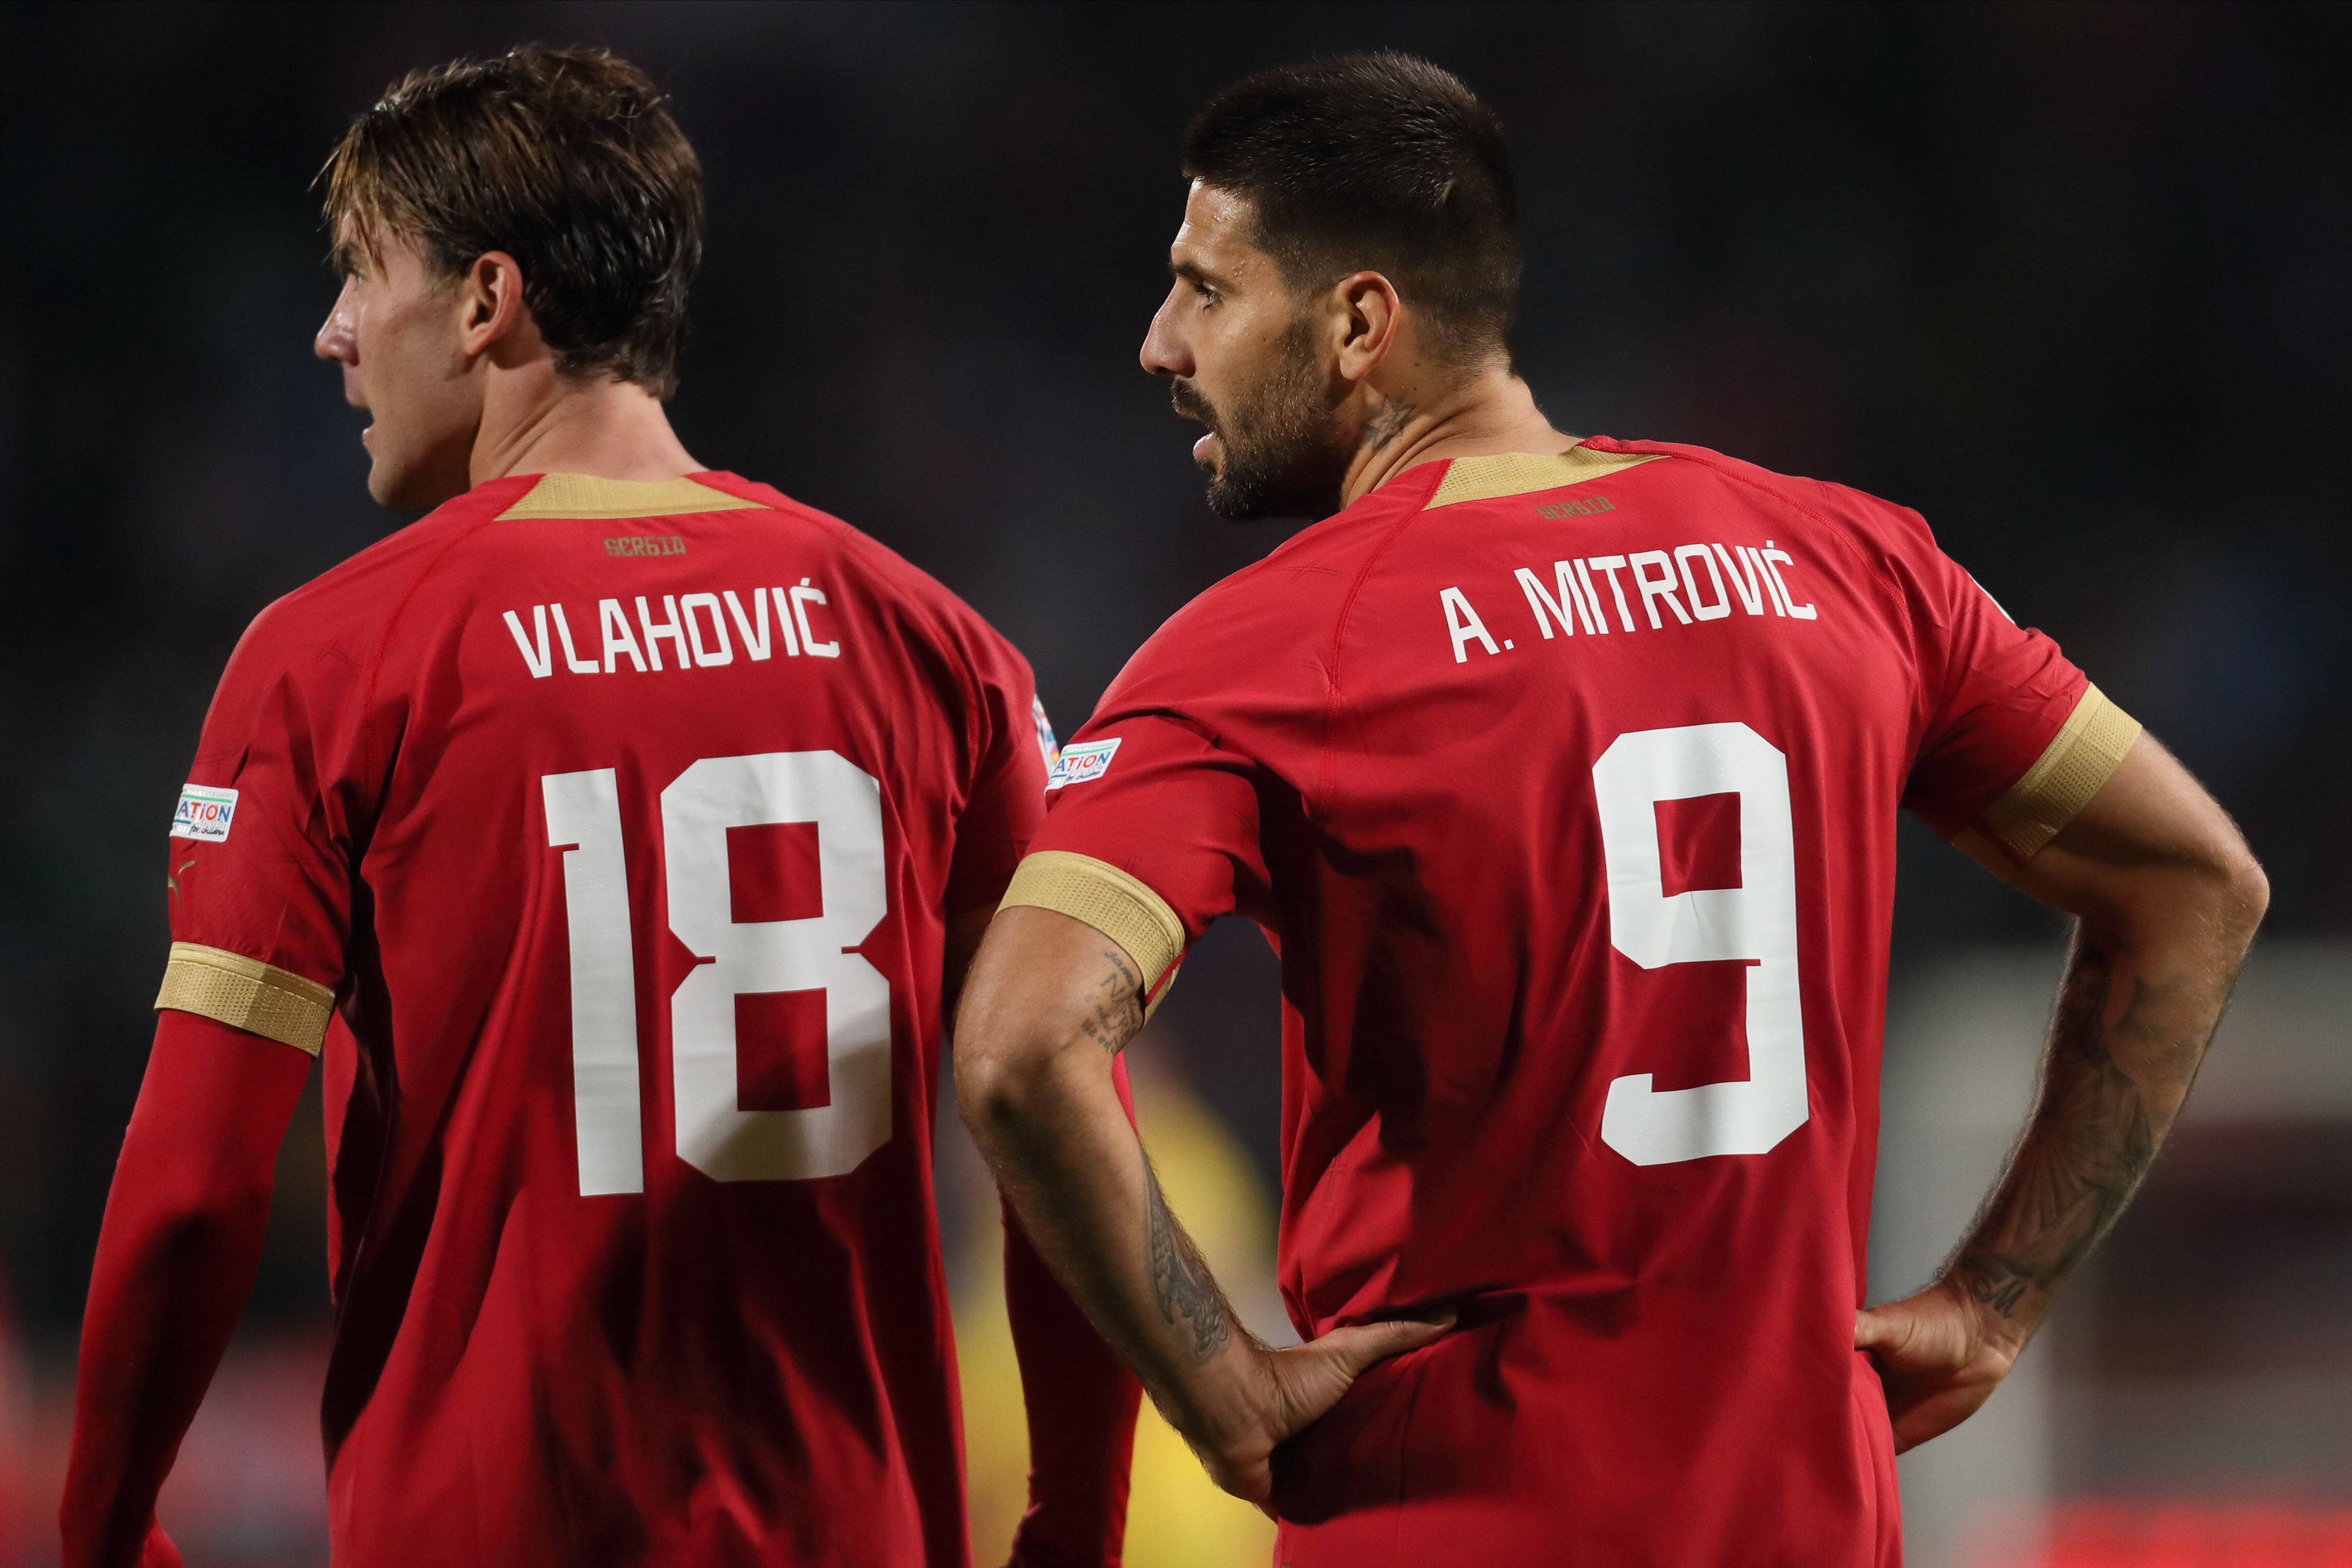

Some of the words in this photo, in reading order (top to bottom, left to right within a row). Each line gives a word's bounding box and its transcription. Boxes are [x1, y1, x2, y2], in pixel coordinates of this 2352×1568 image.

[502, 577, 840, 678] VLAHOVIĆ
[1439, 586, 1515, 664] A.
[1514, 540, 1818, 640] MITROVIĆ
[541, 750, 891, 1197] 18
[1592, 722, 1810, 1166] 9
